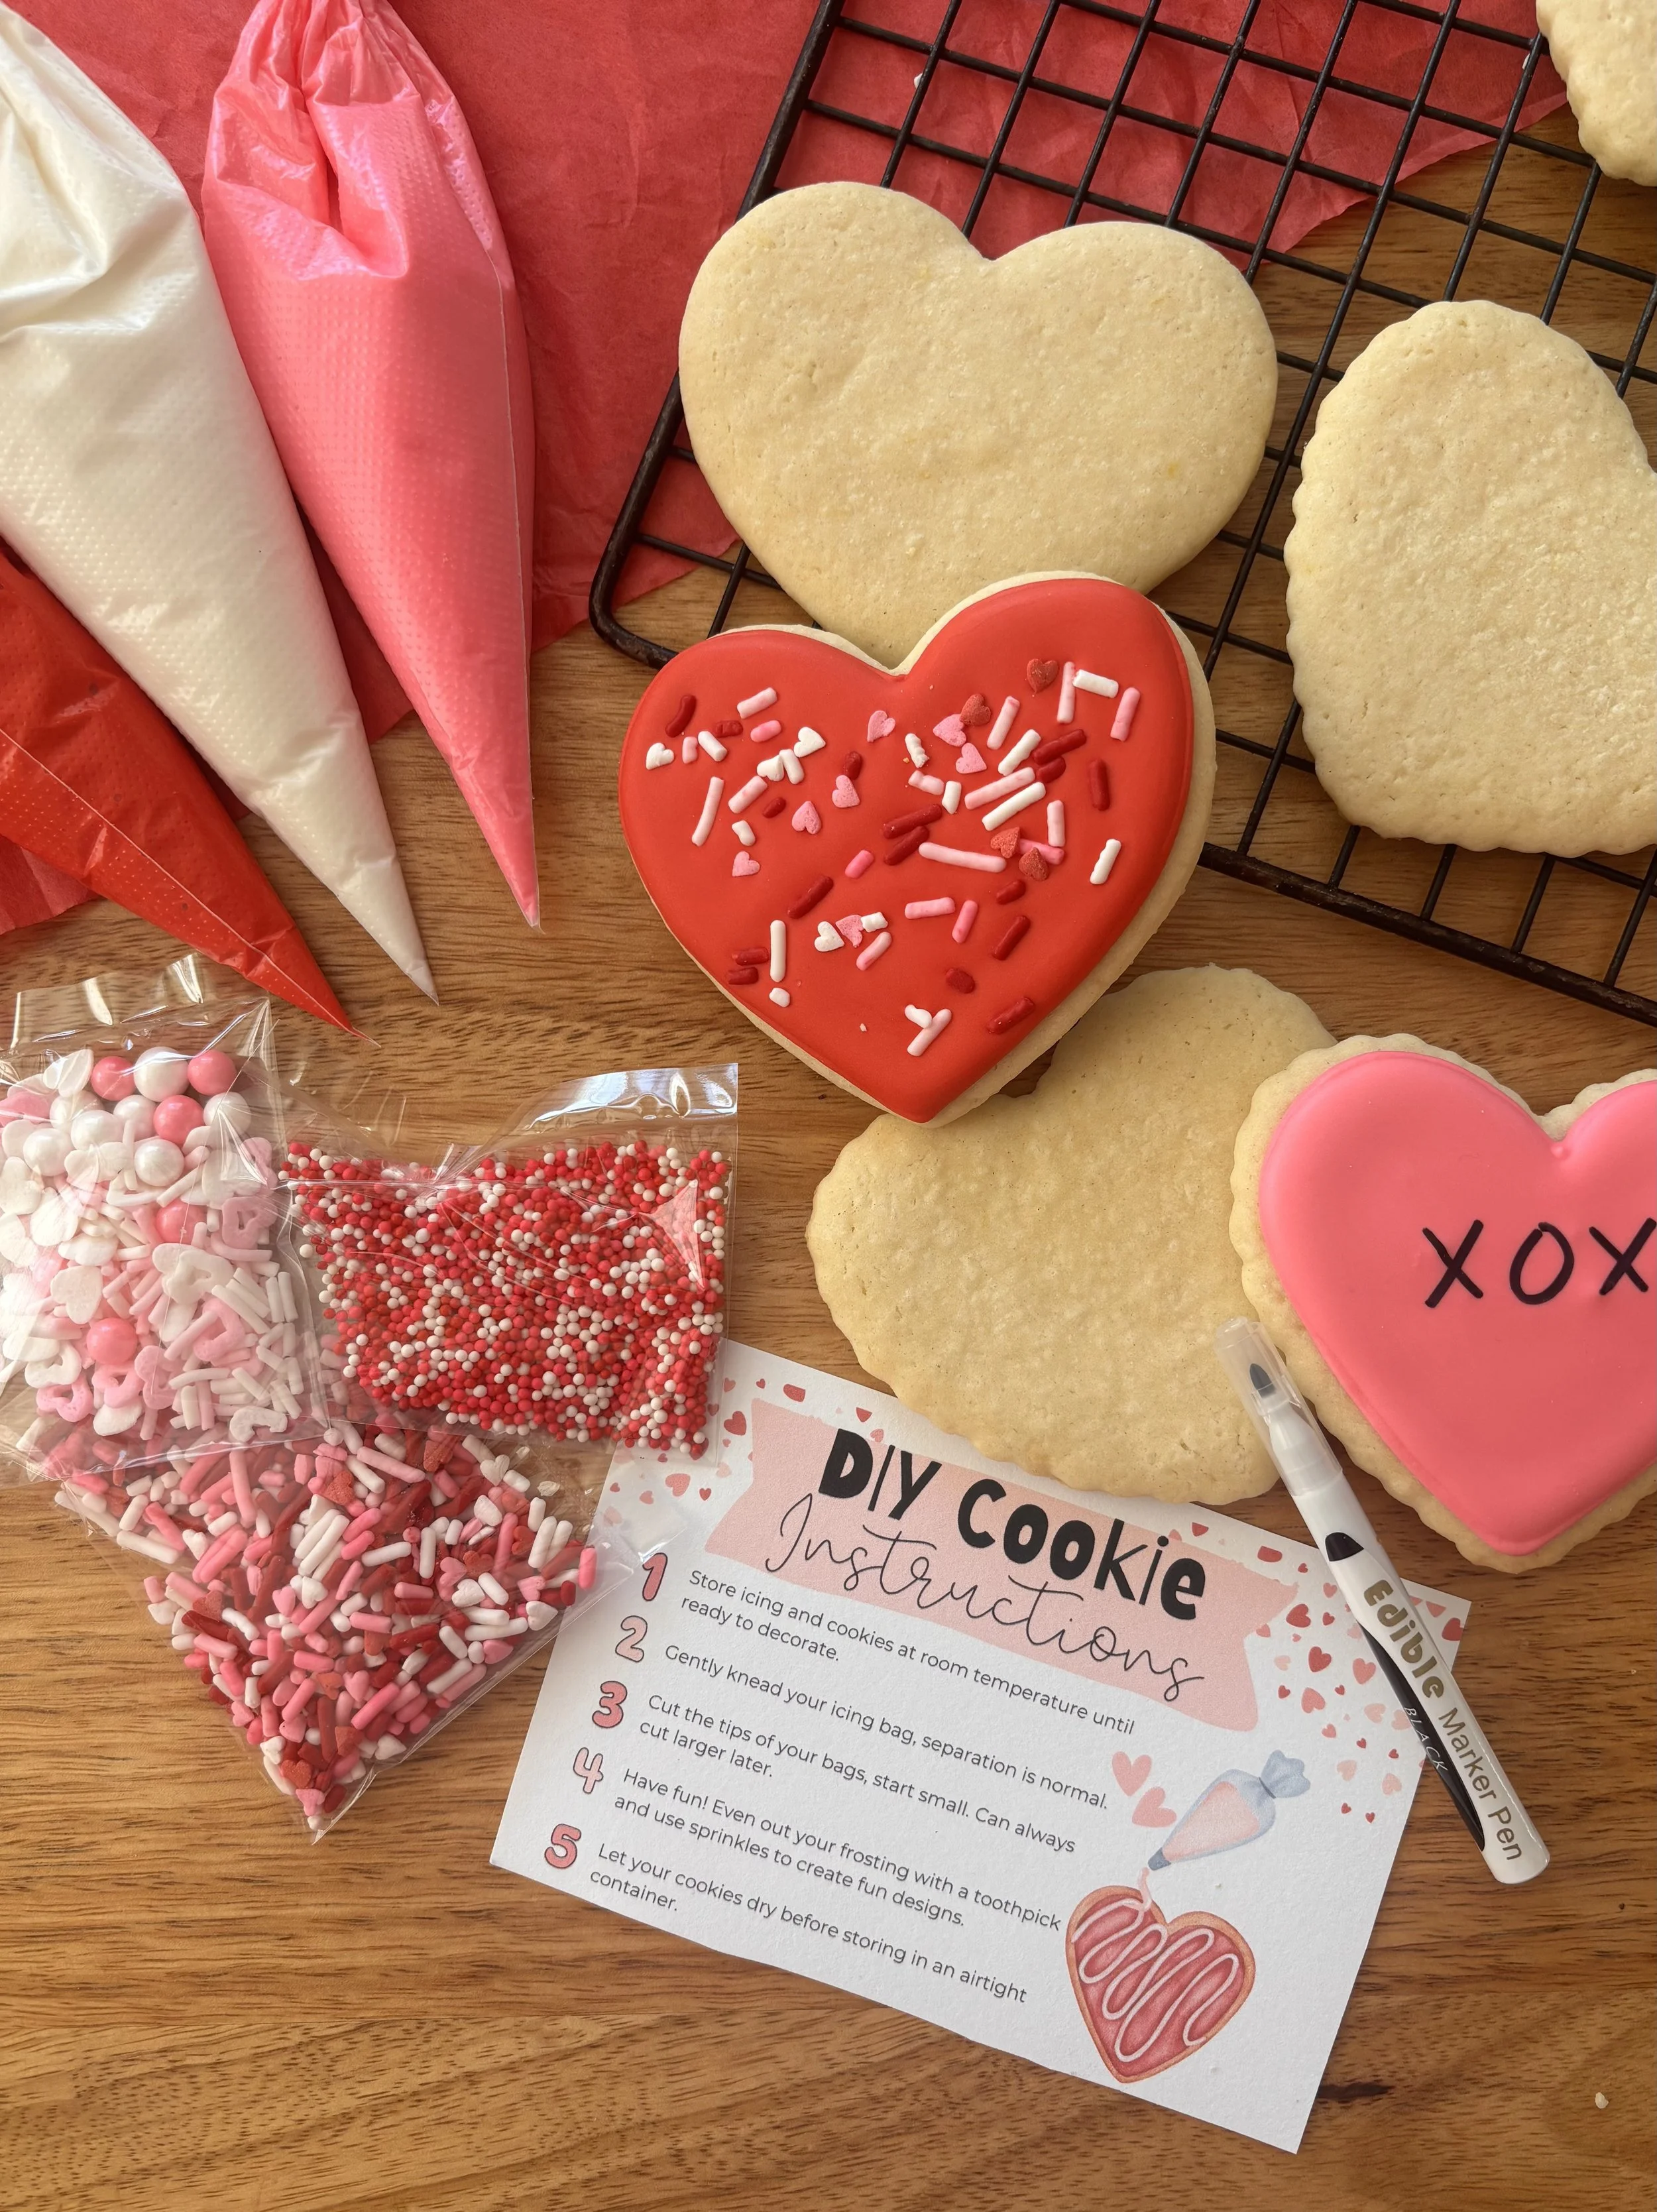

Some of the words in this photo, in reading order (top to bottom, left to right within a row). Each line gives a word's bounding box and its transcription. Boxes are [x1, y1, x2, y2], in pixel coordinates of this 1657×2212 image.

[765, 1493, 1205, 1702] Instructions
[818, 1428, 943, 1521] DIY
[958, 1478, 1206, 1620] Cookie
[614, 1615, 648, 1662] 2
[665, 1645, 724, 1678] Gently
[726, 1664, 784, 1698] knead
[783, 1688, 828, 1712] your
[830, 1700, 875, 1732] icing
[878, 1717, 917, 1747] bag,
[921, 1735, 1017, 1778] separation
[1021, 1766, 1037, 1784] is
[1039, 1776, 1107, 1810] normal.
[642, 1552, 668, 1601] 1
[689, 1570, 736, 1598] Store
[740, 1586, 784, 1618] icing
[787, 1607, 825, 1628] and
[827, 1620, 895, 1653] cookies
[897, 1645, 917, 1660] at
[920, 1652, 968, 1679] room
[973, 1668, 1088, 1719] temperature
[1093, 1712, 1135, 1735] until
[681, 1597, 733, 1626] ready
[735, 1613, 754, 1631] to
[758, 1621, 839, 1662] decorate.
[592, 1680, 628, 1729] 3
[648, 1694, 681, 1717] Cut
[684, 1707, 714, 1729] the
[718, 1718, 752, 1742] tips
[755, 1734, 777, 1749] of
[773, 1741, 819, 1764] your
[821, 1752, 868, 1785] bags,
[872, 1775, 915, 1798] start
[917, 1790, 969, 1818] small.
[975, 1807, 1010, 1832] Can
[1014, 1822, 1076, 1853] always
[640, 1721, 670, 1741] cut
[673, 1729, 727, 1761] larger
[729, 1748, 772, 1778] later.
[1363, 1579, 1445, 1698] Edible
[1438, 1707, 1497, 1800] Marker
[1487, 1805, 1523, 1861] Pen
[1404, 1707, 1448, 1771] BLACK
[544, 1824, 582, 1869] 5
[598, 1843, 628, 1866] Let
[627, 1857, 672, 1881] your
[675, 1873, 744, 1906] cookies
[746, 1896, 777, 1920] dry
[780, 1905, 839, 1938] before
[842, 1930, 907, 1964] storing
[911, 1950, 928, 1970] in
[932, 1961, 955, 1979] an
[959, 1969, 1027, 2003] airtight
[572, 1747, 604, 1794] 4
[623, 1768, 669, 1796] Have
[672, 1784, 709, 1810] fun!
[712, 1798, 756, 1828] Even
[760, 1819, 792, 1840] out
[792, 1830, 837, 1853] your
[840, 1842, 910, 1883] frosting
[915, 1870, 954, 1894] with
[958, 1887, 969, 1900] a
[974, 1889, 1062, 1932] toothpick
[590, 1871, 677, 1912] container.
[614, 1796, 651, 1818] and
[654, 1809, 685, 1830] use
[688, 1822, 770, 1859] sprinkles
[773, 1849, 792, 1867] to
[796, 1859, 854, 1887] create
[857, 1876, 887, 1900] fun
[891, 1890, 964, 1926] designs.
